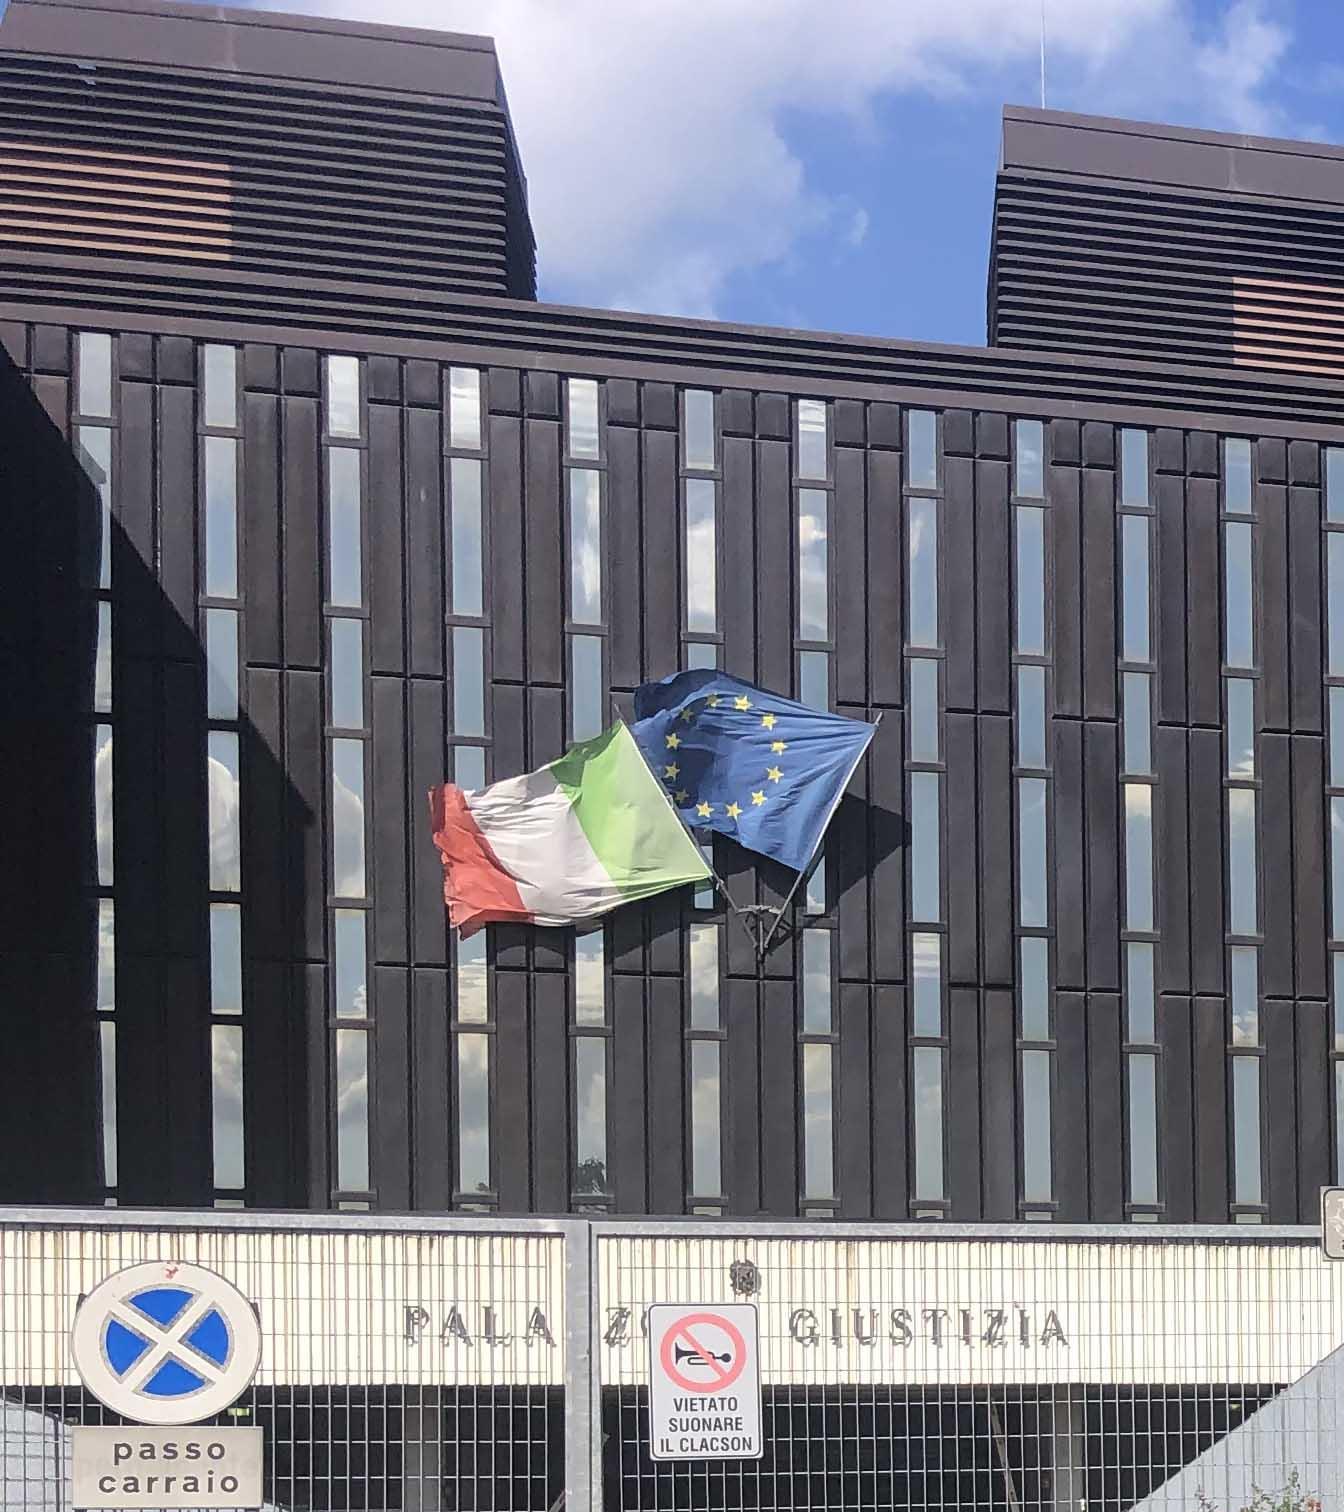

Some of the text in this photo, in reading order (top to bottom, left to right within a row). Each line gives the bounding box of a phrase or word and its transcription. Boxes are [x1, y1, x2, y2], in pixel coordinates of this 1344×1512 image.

[403, 1305, 1071, 1349] PALAZ GIUSTIZIA
[673, 1397, 738, 1412] VIETATO
[668, 1417, 743, 1432] SUONARE
[114, 1442, 226, 1466] passo
[660, 1437, 753, 1452] IL CLACSON
[99, 1470, 239, 1494] carraio
